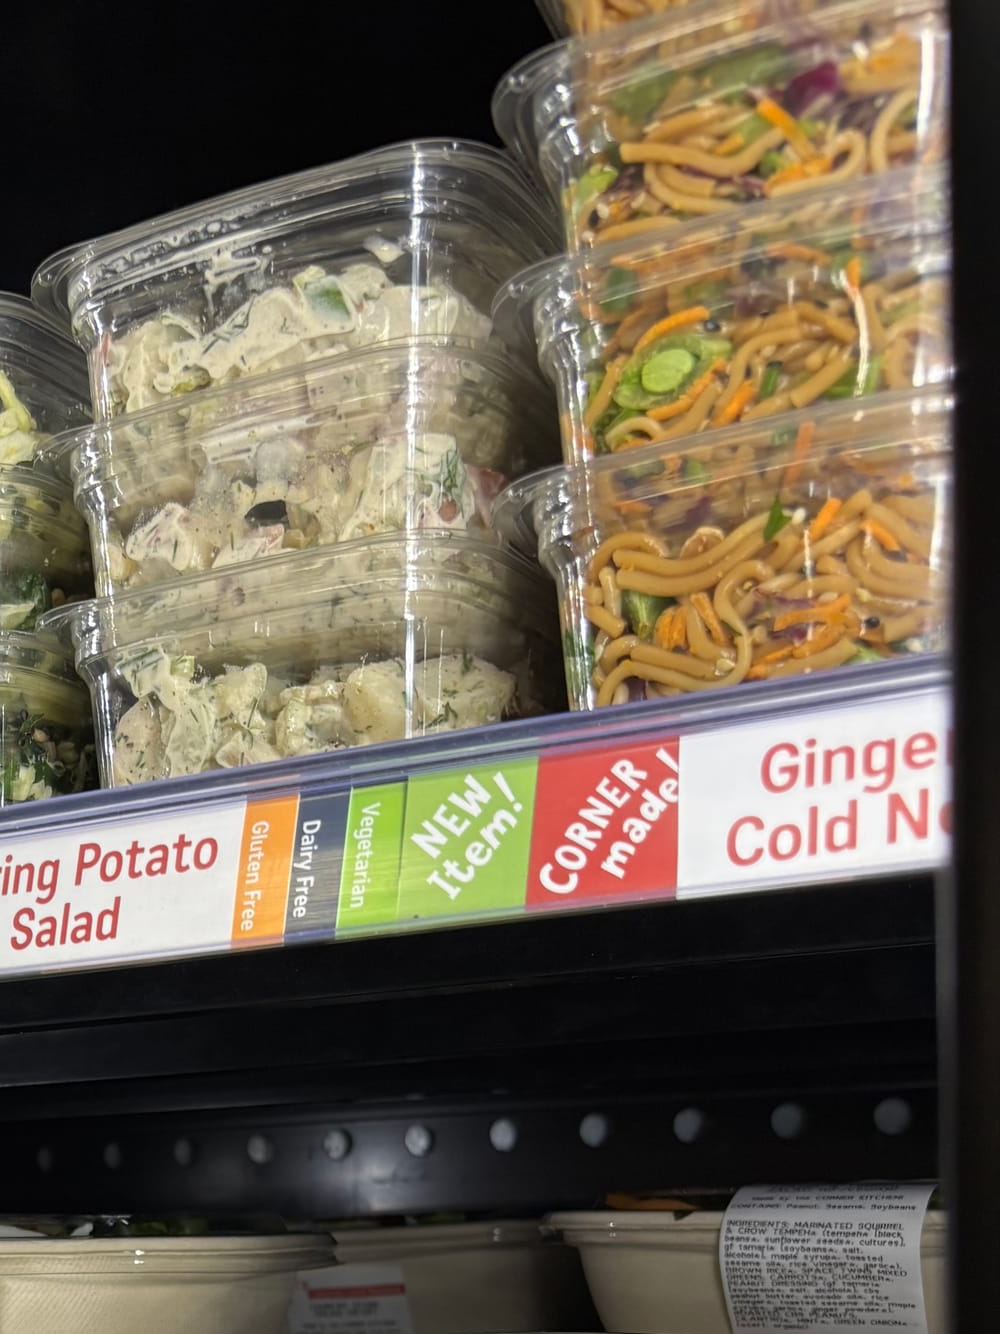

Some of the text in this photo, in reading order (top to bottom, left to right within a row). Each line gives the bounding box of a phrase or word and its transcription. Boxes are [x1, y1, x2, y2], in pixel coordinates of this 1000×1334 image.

[75, 834, 219, 887] Potato
[349, 802, 381, 908] Vegetarian
[410, 773, 492, 860] NEW
[426, 771, 523, 901] Item!
[539, 758, 648, 894] CORNER
[600, 748, 679, 880] made!
[726, 799, 858, 867] Cold
[240, 820, 270, 932] Gluten Free
[292, 820, 321, 919] Dairy Free
[10, 896, 121, 951] Salad
